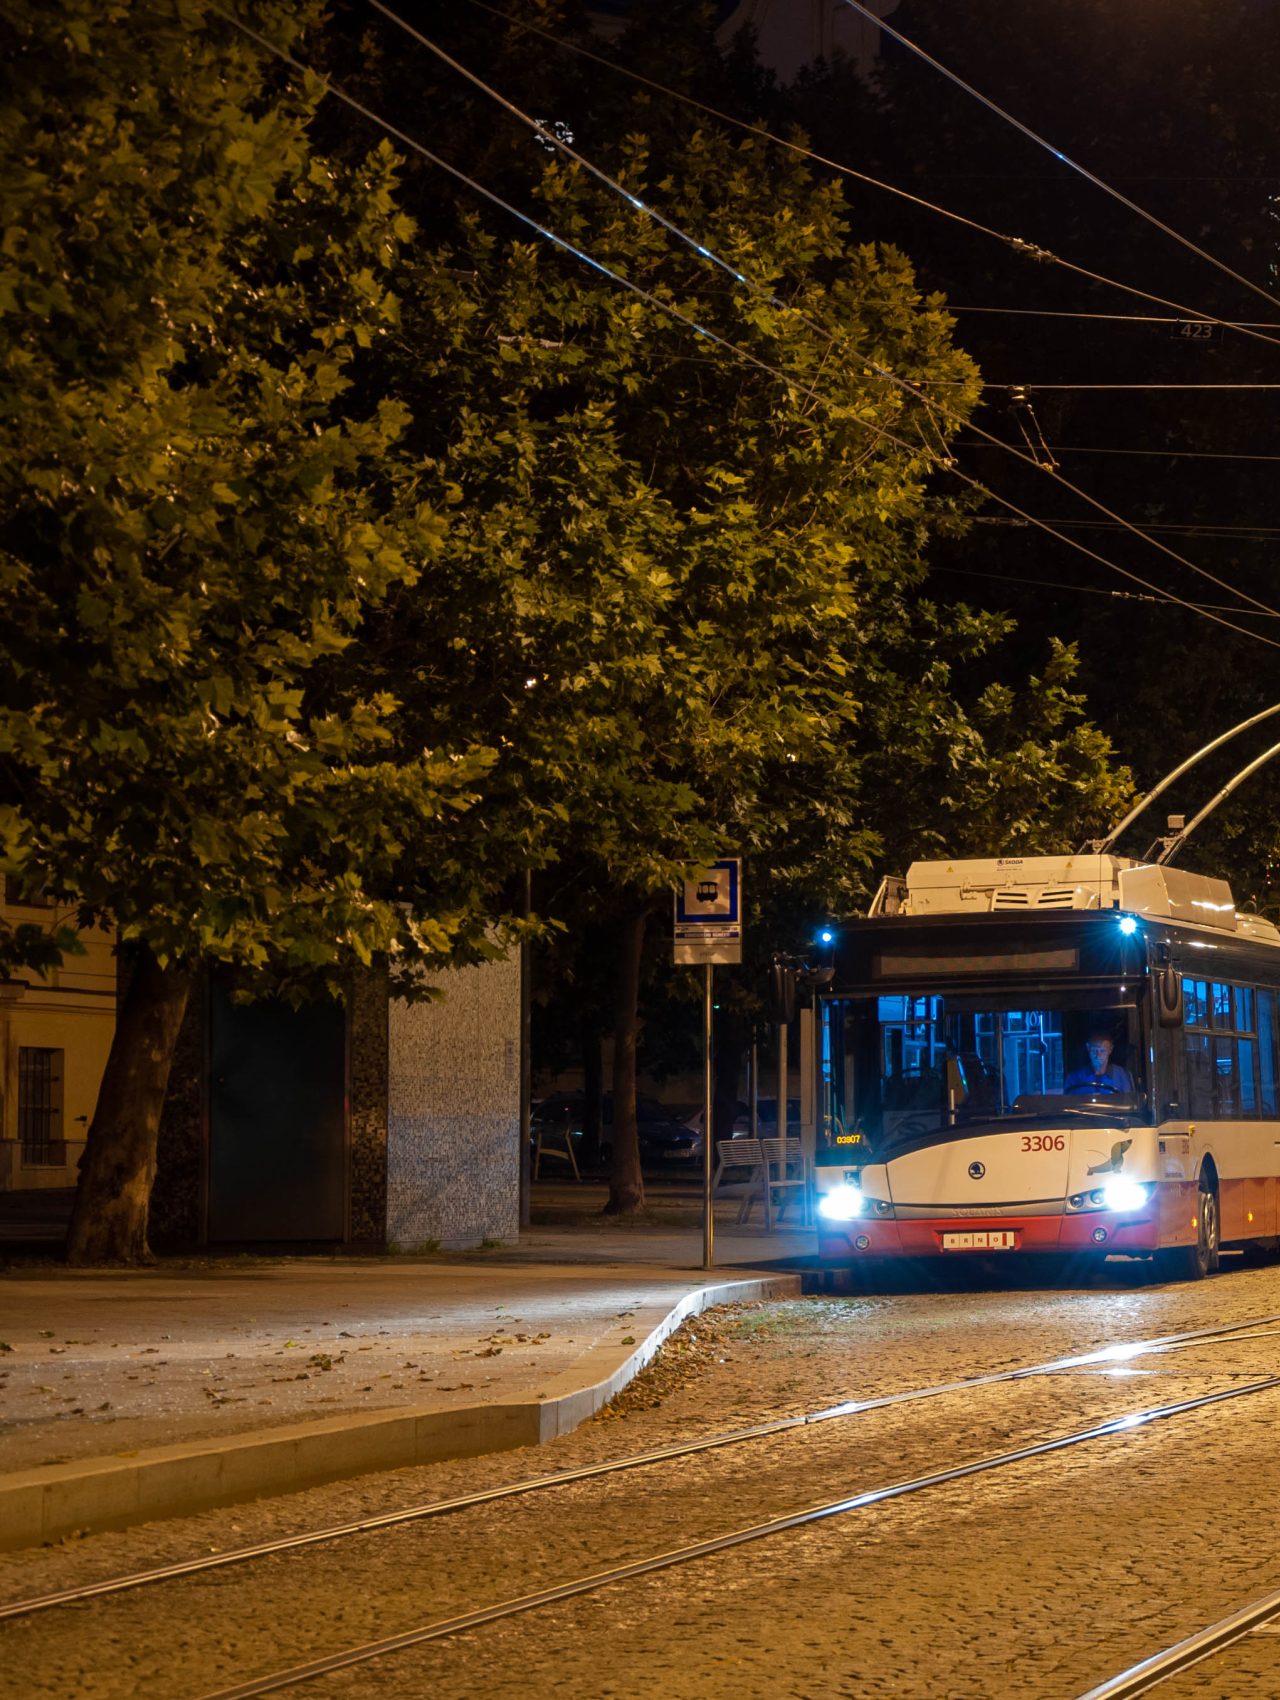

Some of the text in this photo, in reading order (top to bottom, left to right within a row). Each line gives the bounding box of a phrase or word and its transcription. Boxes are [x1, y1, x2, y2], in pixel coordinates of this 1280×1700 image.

[1180, 323, 1213, 338] 423
[1021, 1135, 1065, 1153] 3306
[950, 1236, 999, 1244] BRNO
